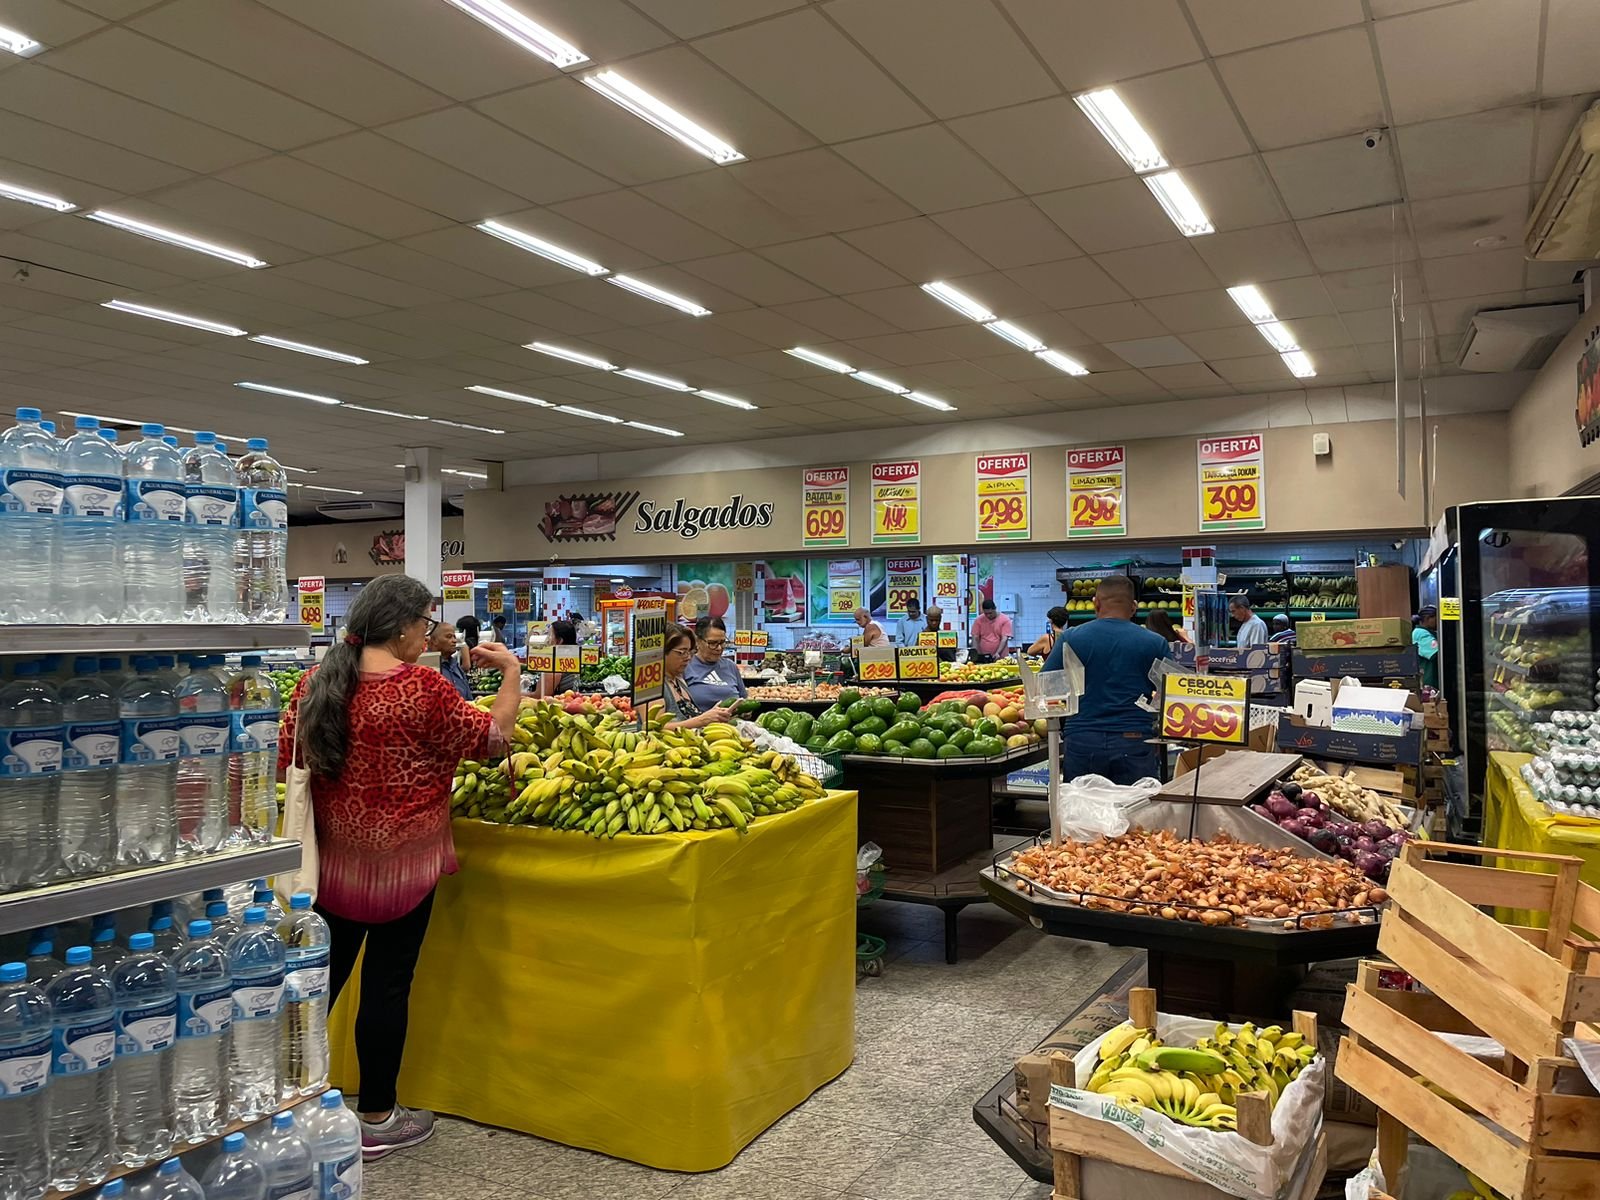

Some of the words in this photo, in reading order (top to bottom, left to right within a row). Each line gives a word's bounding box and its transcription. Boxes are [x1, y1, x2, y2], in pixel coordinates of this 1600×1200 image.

[1202, 439, 1259, 454] OFERTA
[1070, 450, 1121, 464] OFERTA
[979, 457, 1026, 470] OFERTA
[874, 465, 917, 476] OFERTA
[806, 471, 846, 481] OFERTA
[1072, 477, 1095, 485] LIMÃO
[806, 492, 833, 502] BATATA
[634, 494, 774, 539] Salgados
[980, 496, 1024, 528] 2,98
[806, 509, 844, 537] 6,99
[888, 560, 920, 569] OFERTA
[299, 580, 323, 588] OFERTA
[443, 575, 472, 583] OFERTA
[900, 648, 928, 657] ABACATE
[1178, 678, 1233, 691] CEBOLA
[1187, 688, 1222, 697] PICLES
